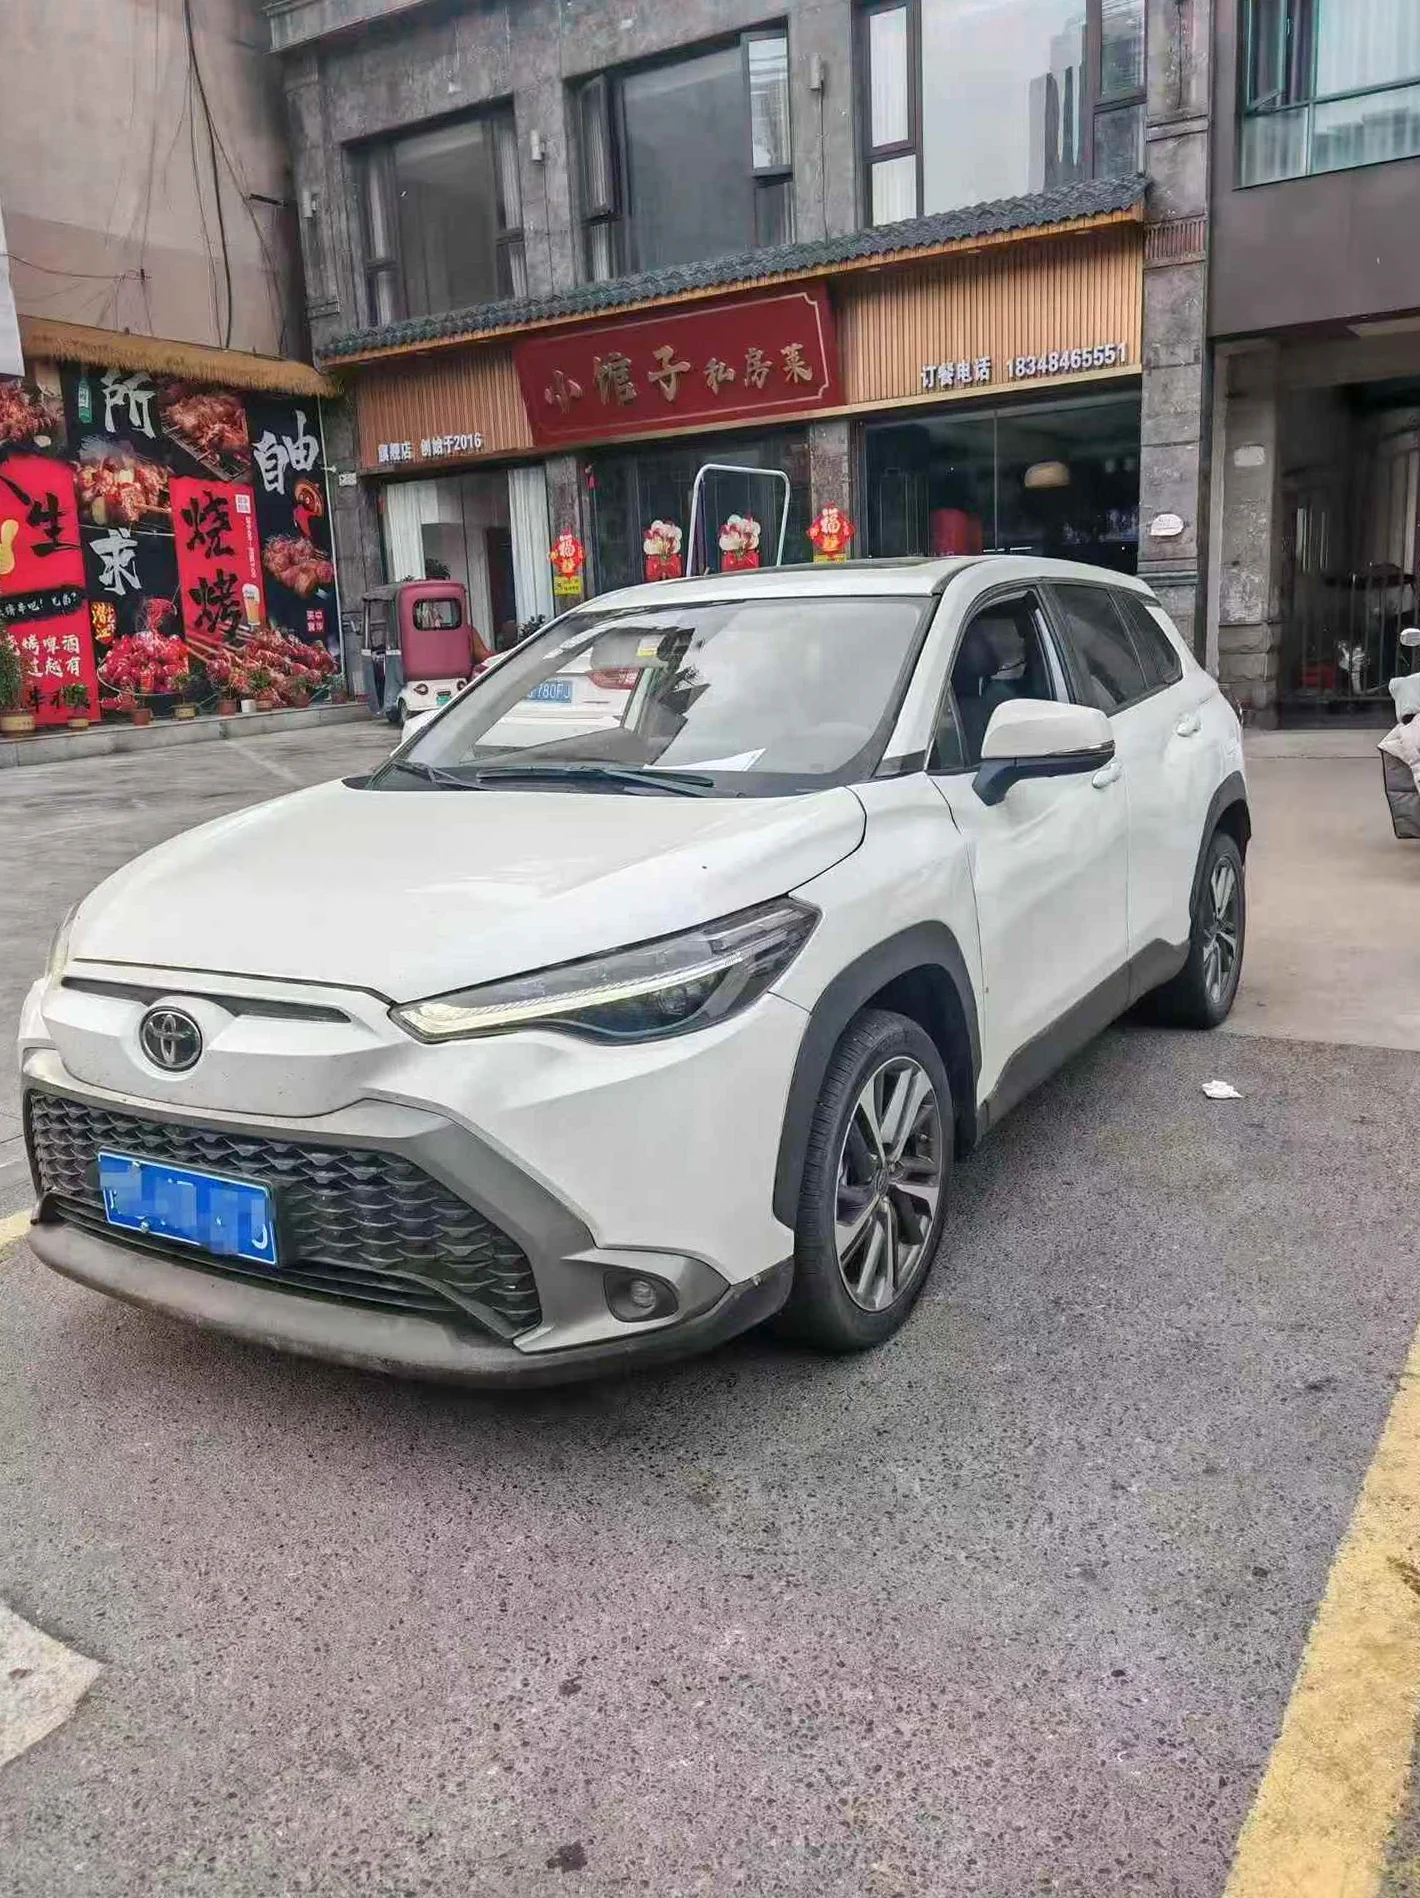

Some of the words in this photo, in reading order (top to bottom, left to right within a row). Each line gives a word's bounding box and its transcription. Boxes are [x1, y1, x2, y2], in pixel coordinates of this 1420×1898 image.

[921, 356, 991, 388] 订餐电话
[1006, 342, 1128, 378] 18348465551
[103, 371, 156, 439] 所
[252, 409, 320, 495] 自由
[89, 527, 142, 596] 求
[181, 490, 242, 648] 烧烤
